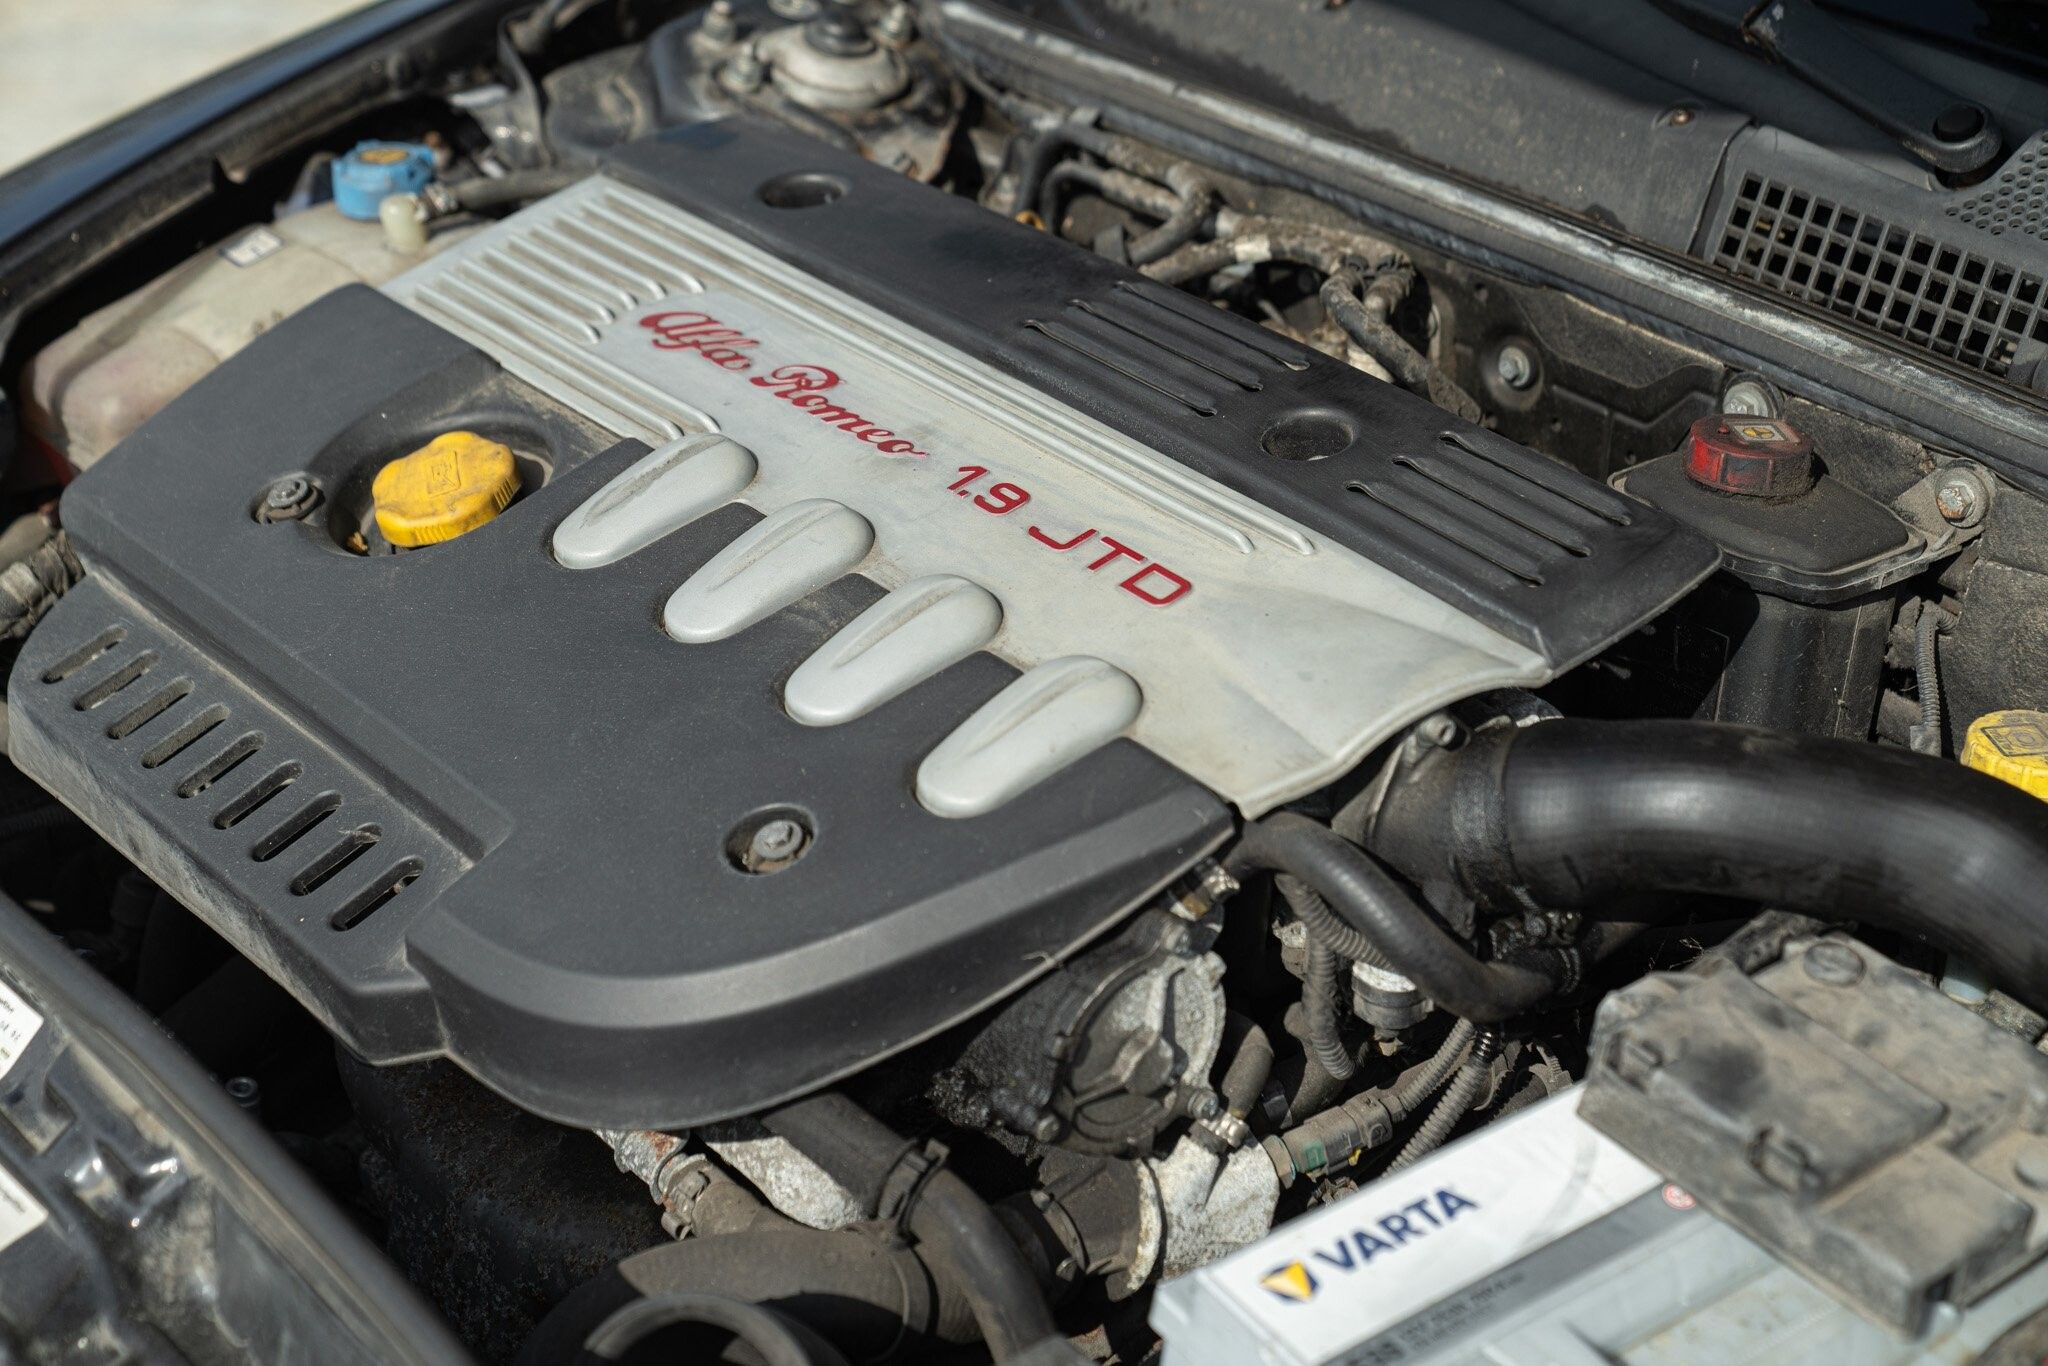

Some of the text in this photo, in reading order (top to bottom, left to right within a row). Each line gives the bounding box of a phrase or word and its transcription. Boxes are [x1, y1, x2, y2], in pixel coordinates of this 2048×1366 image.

[639, 311, 1192, 606] Alfa Romeo 1.9 JTD
[1313, 1189, 1478, 1271] VARTA
